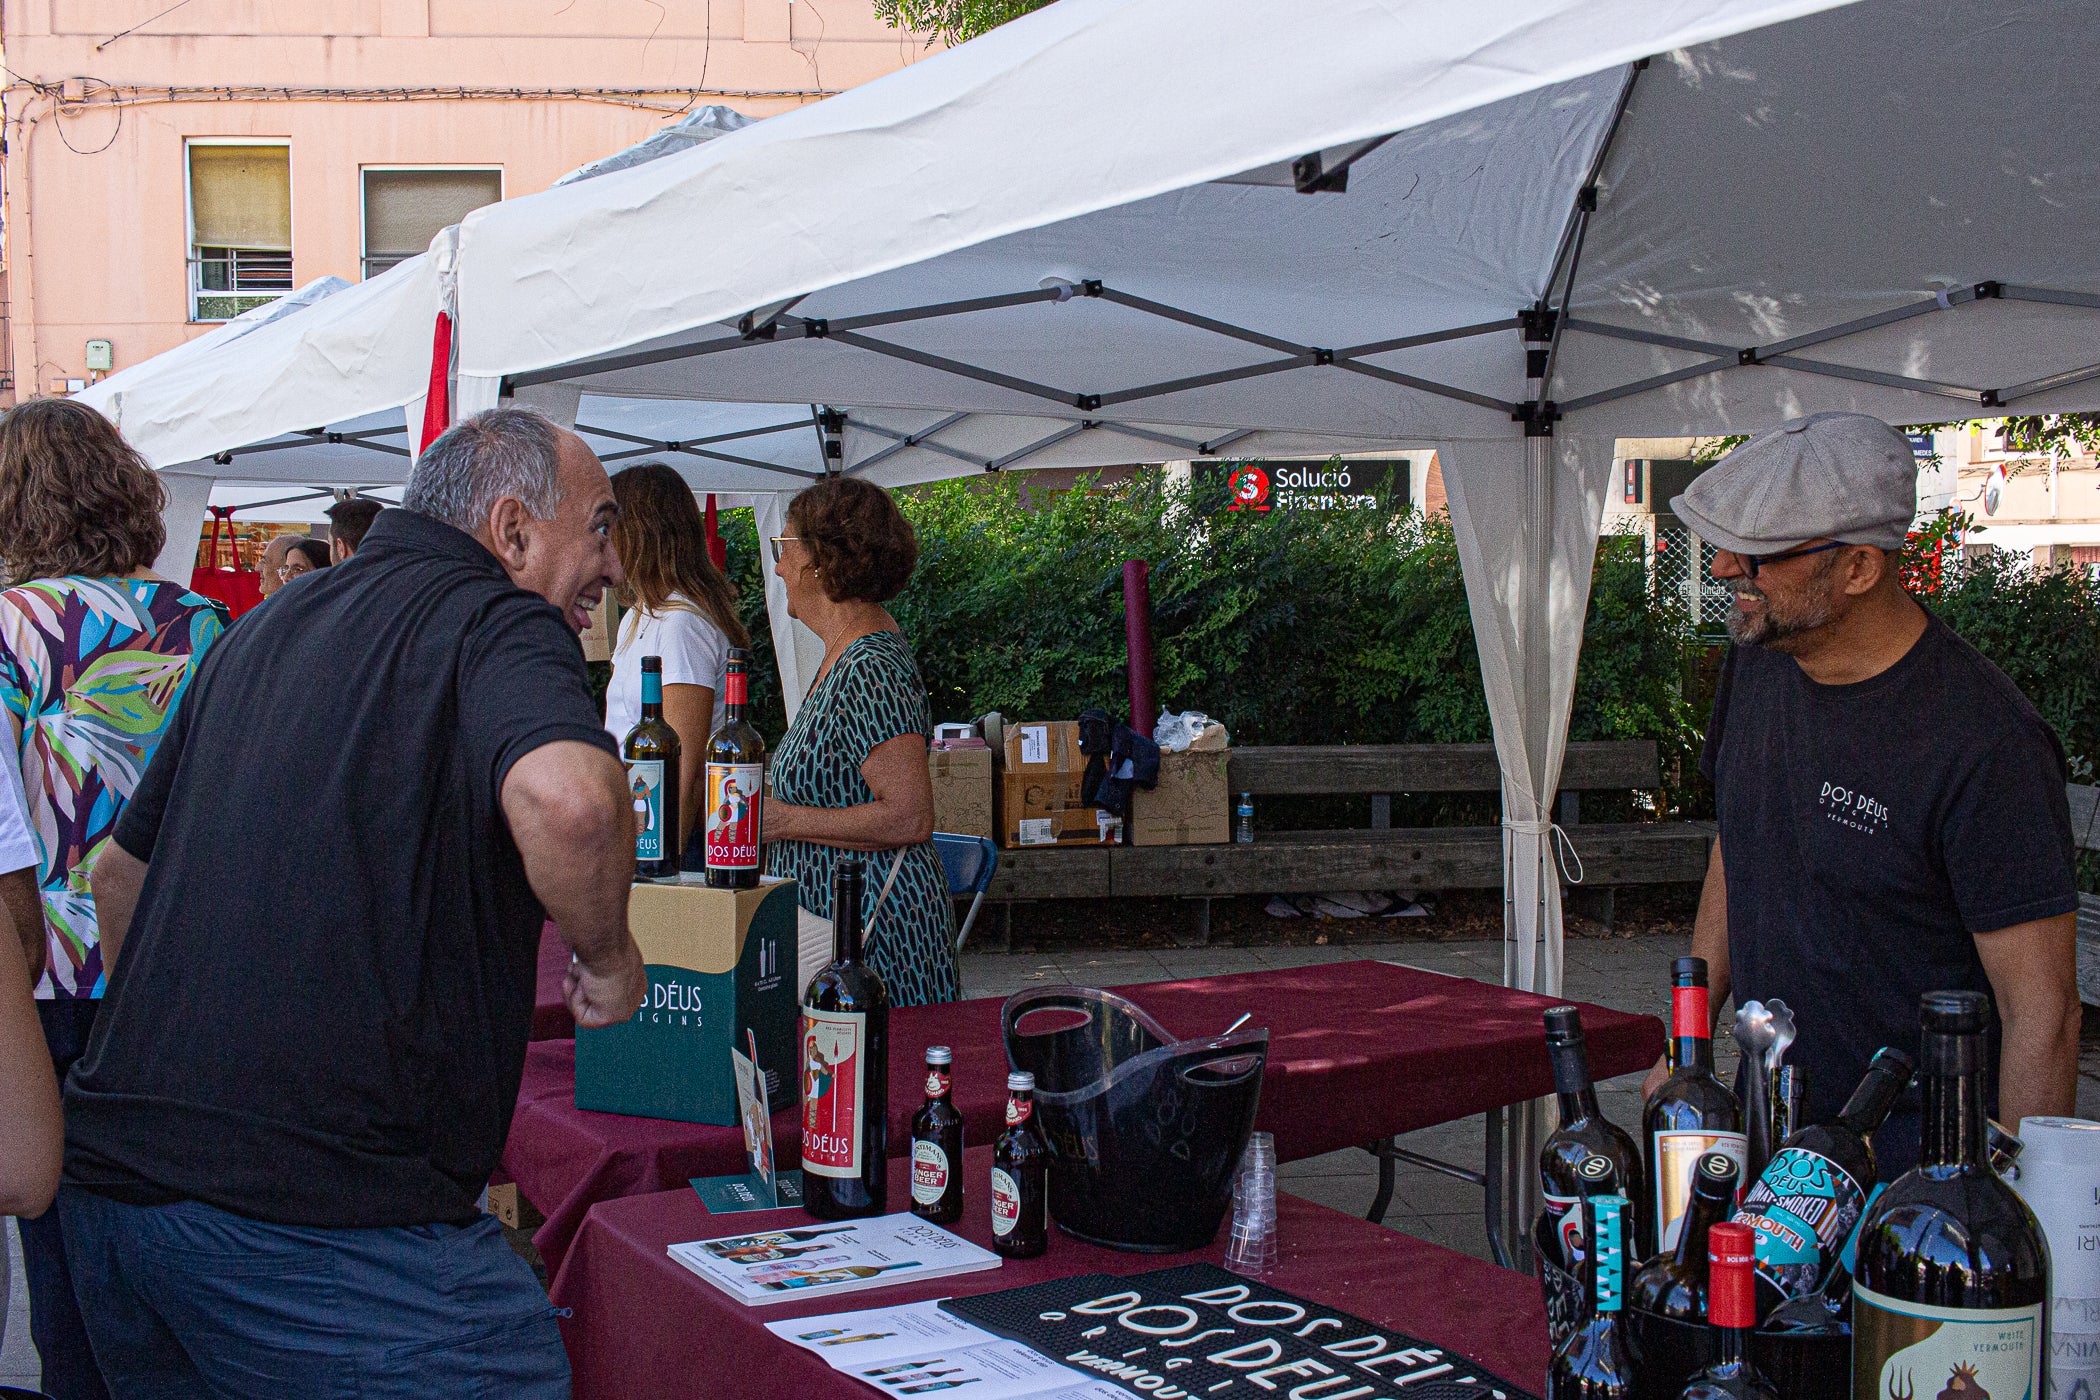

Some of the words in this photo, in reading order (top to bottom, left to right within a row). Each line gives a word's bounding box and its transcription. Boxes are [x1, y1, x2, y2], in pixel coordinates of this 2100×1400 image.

[1275, 466, 1351, 488] Solució
[1821, 781, 1853, 805] DOS
[1857, 795, 1888, 821] DÉUS
[1827, 812, 1874, 834] VERMOUTH
[708, 845, 729, 857] DOS
[733, 845, 756, 857] DÉUS
[654, 980, 702, 1012] DÉUS
[639, 1011, 702, 1027] IGINS
[812, 1133, 848, 1154] DÉUS
[1769, 1155, 1832, 1190] DOS
[1769, 1173, 1808, 1195] DÉUS
[1071, 1291, 1236, 1347] DOS
[1181, 1285, 1342, 1336] DOS
[1998, 1330, 2024, 1340] WHITE
[1973, 1342, 2024, 1352] VERMOUTH
